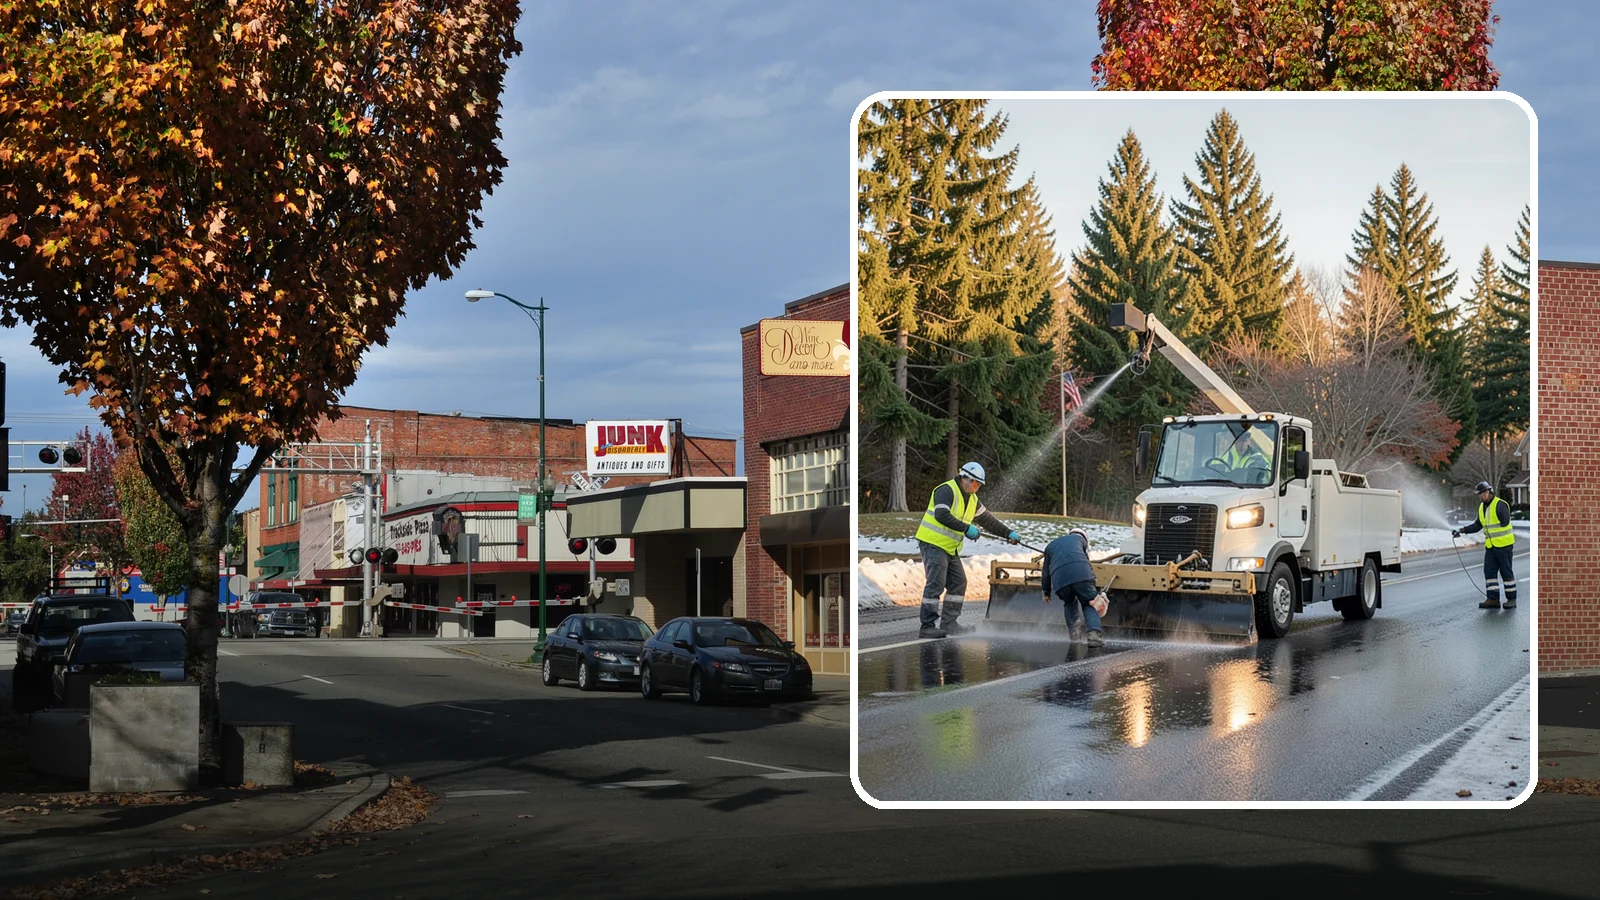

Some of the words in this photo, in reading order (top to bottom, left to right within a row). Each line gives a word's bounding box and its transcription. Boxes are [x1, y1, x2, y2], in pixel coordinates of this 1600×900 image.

[596, 425, 665, 457] JUNK
[607, 446, 646, 454] DISORDERLY
[597, 461, 628, 470] ANTIQUES
[631, 461, 644, 469] AND
[647, 460, 665, 469] GIFTS
[414, 519, 429, 535] Pizza
